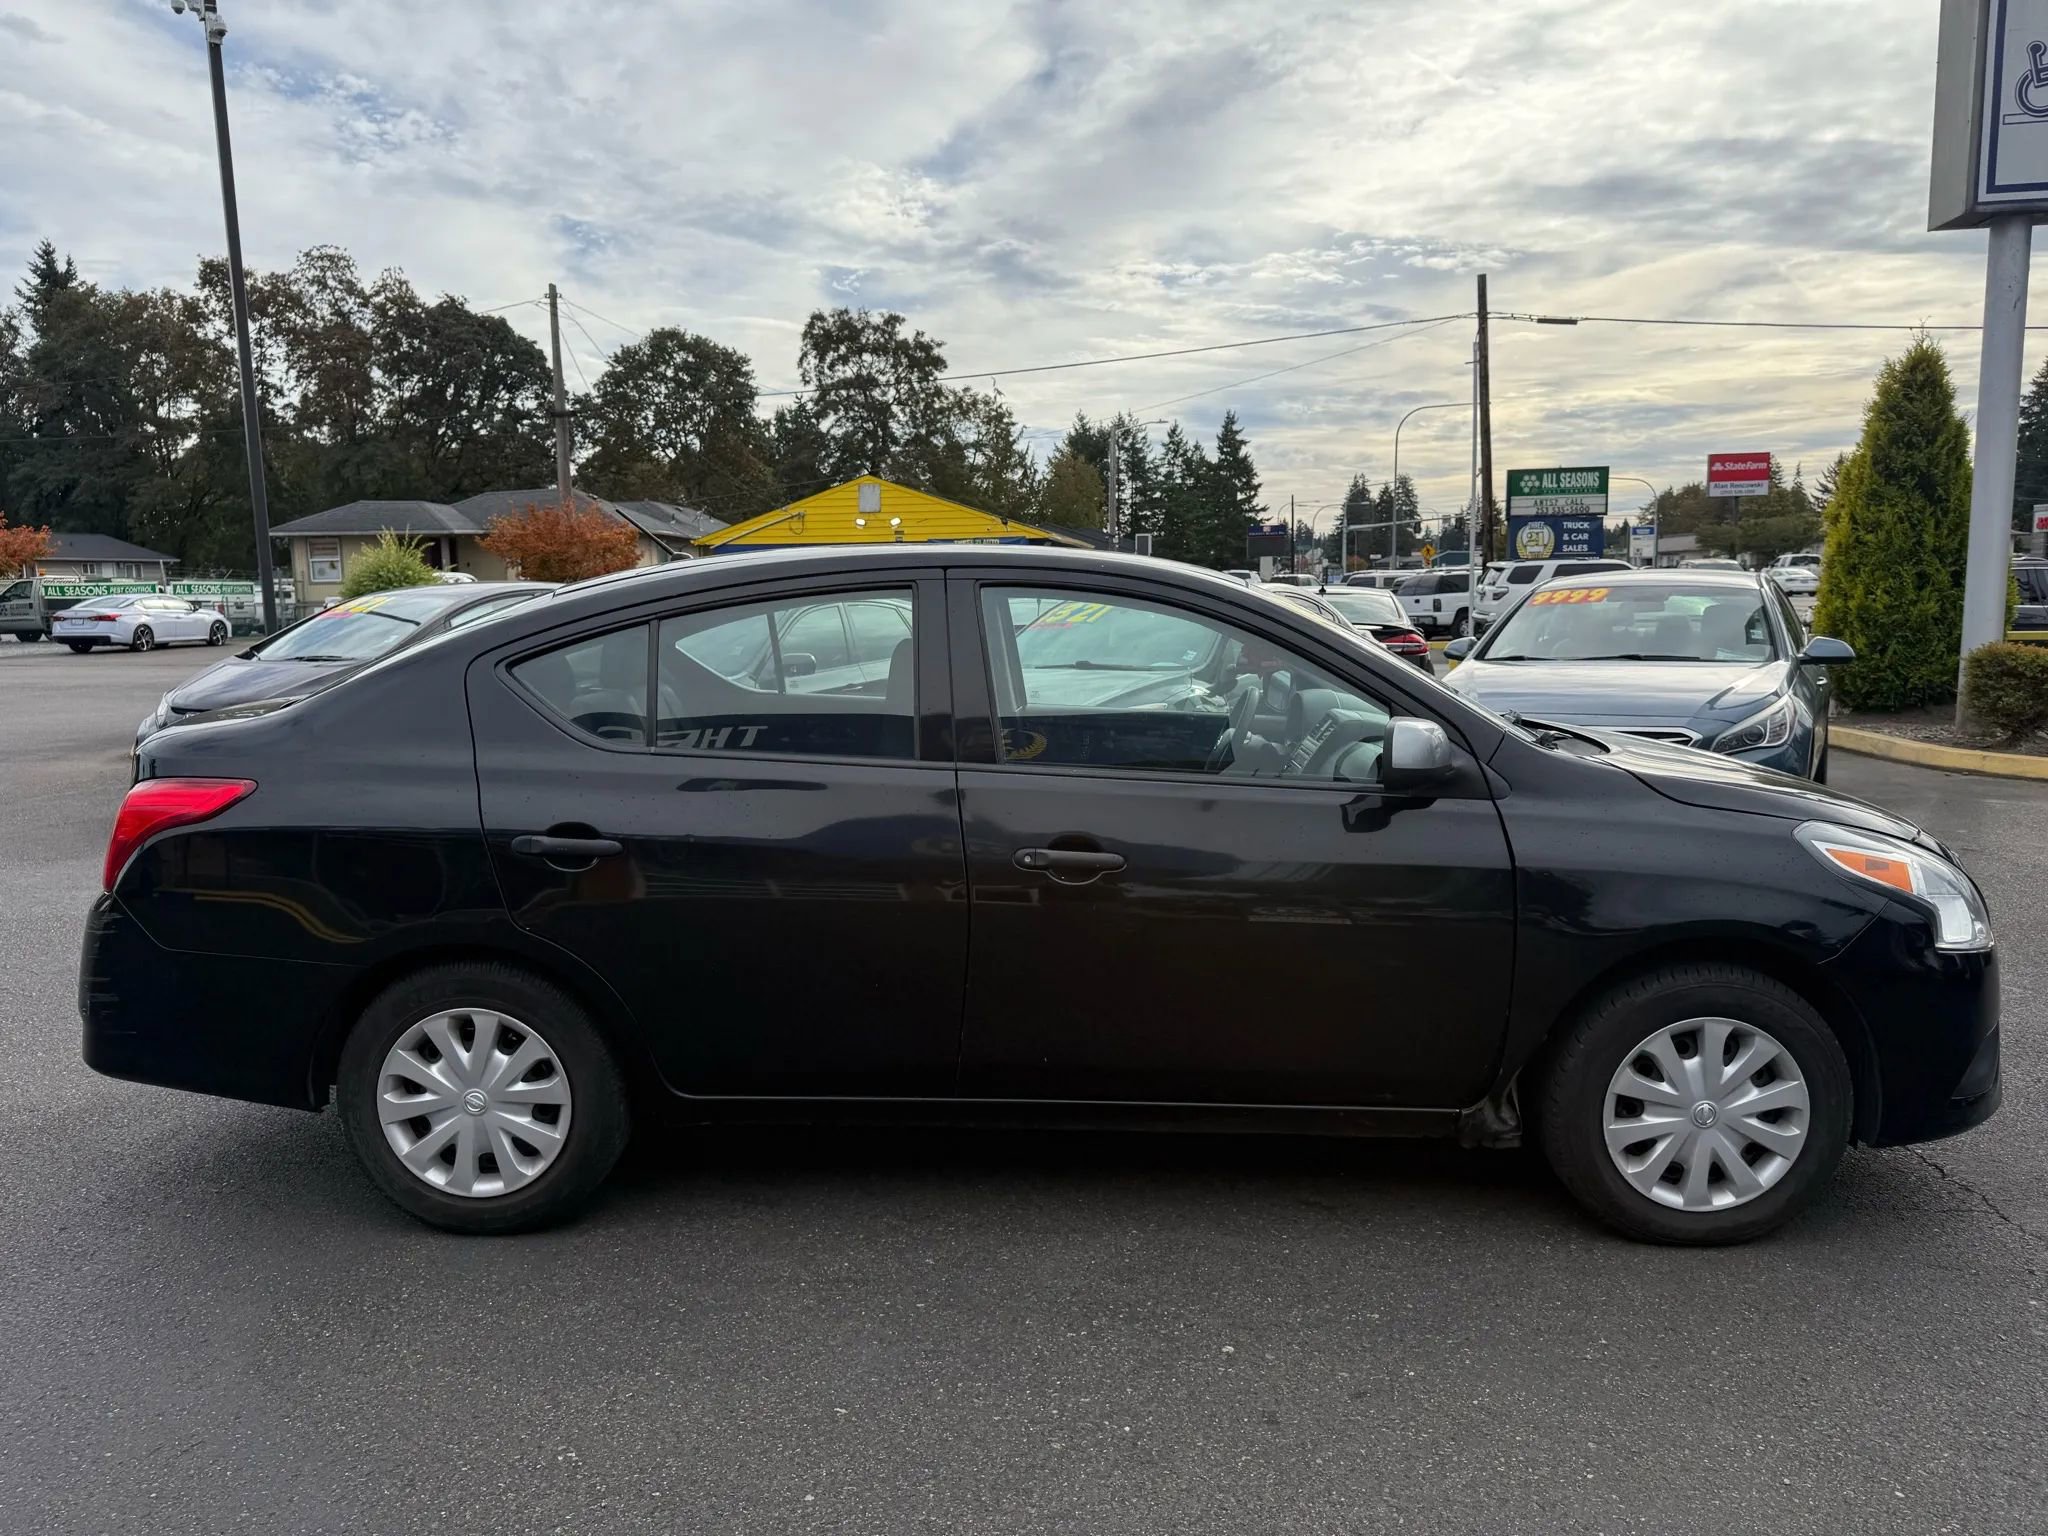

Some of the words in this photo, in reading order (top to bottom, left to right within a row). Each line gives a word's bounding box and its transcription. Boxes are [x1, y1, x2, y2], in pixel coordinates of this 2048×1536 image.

[1542, 473, 1558, 488] ALL
[1560, 472, 1599, 488] SEASONS
[1563, 533, 1570, 541] &
[1562, 544, 1588, 552] SALES
[47, 586, 62, 596] ALL
[64, 585, 108, 596] SEASONS
[176, 585, 189, 594] ALL
[191, 584, 221, 594] SEASONS
